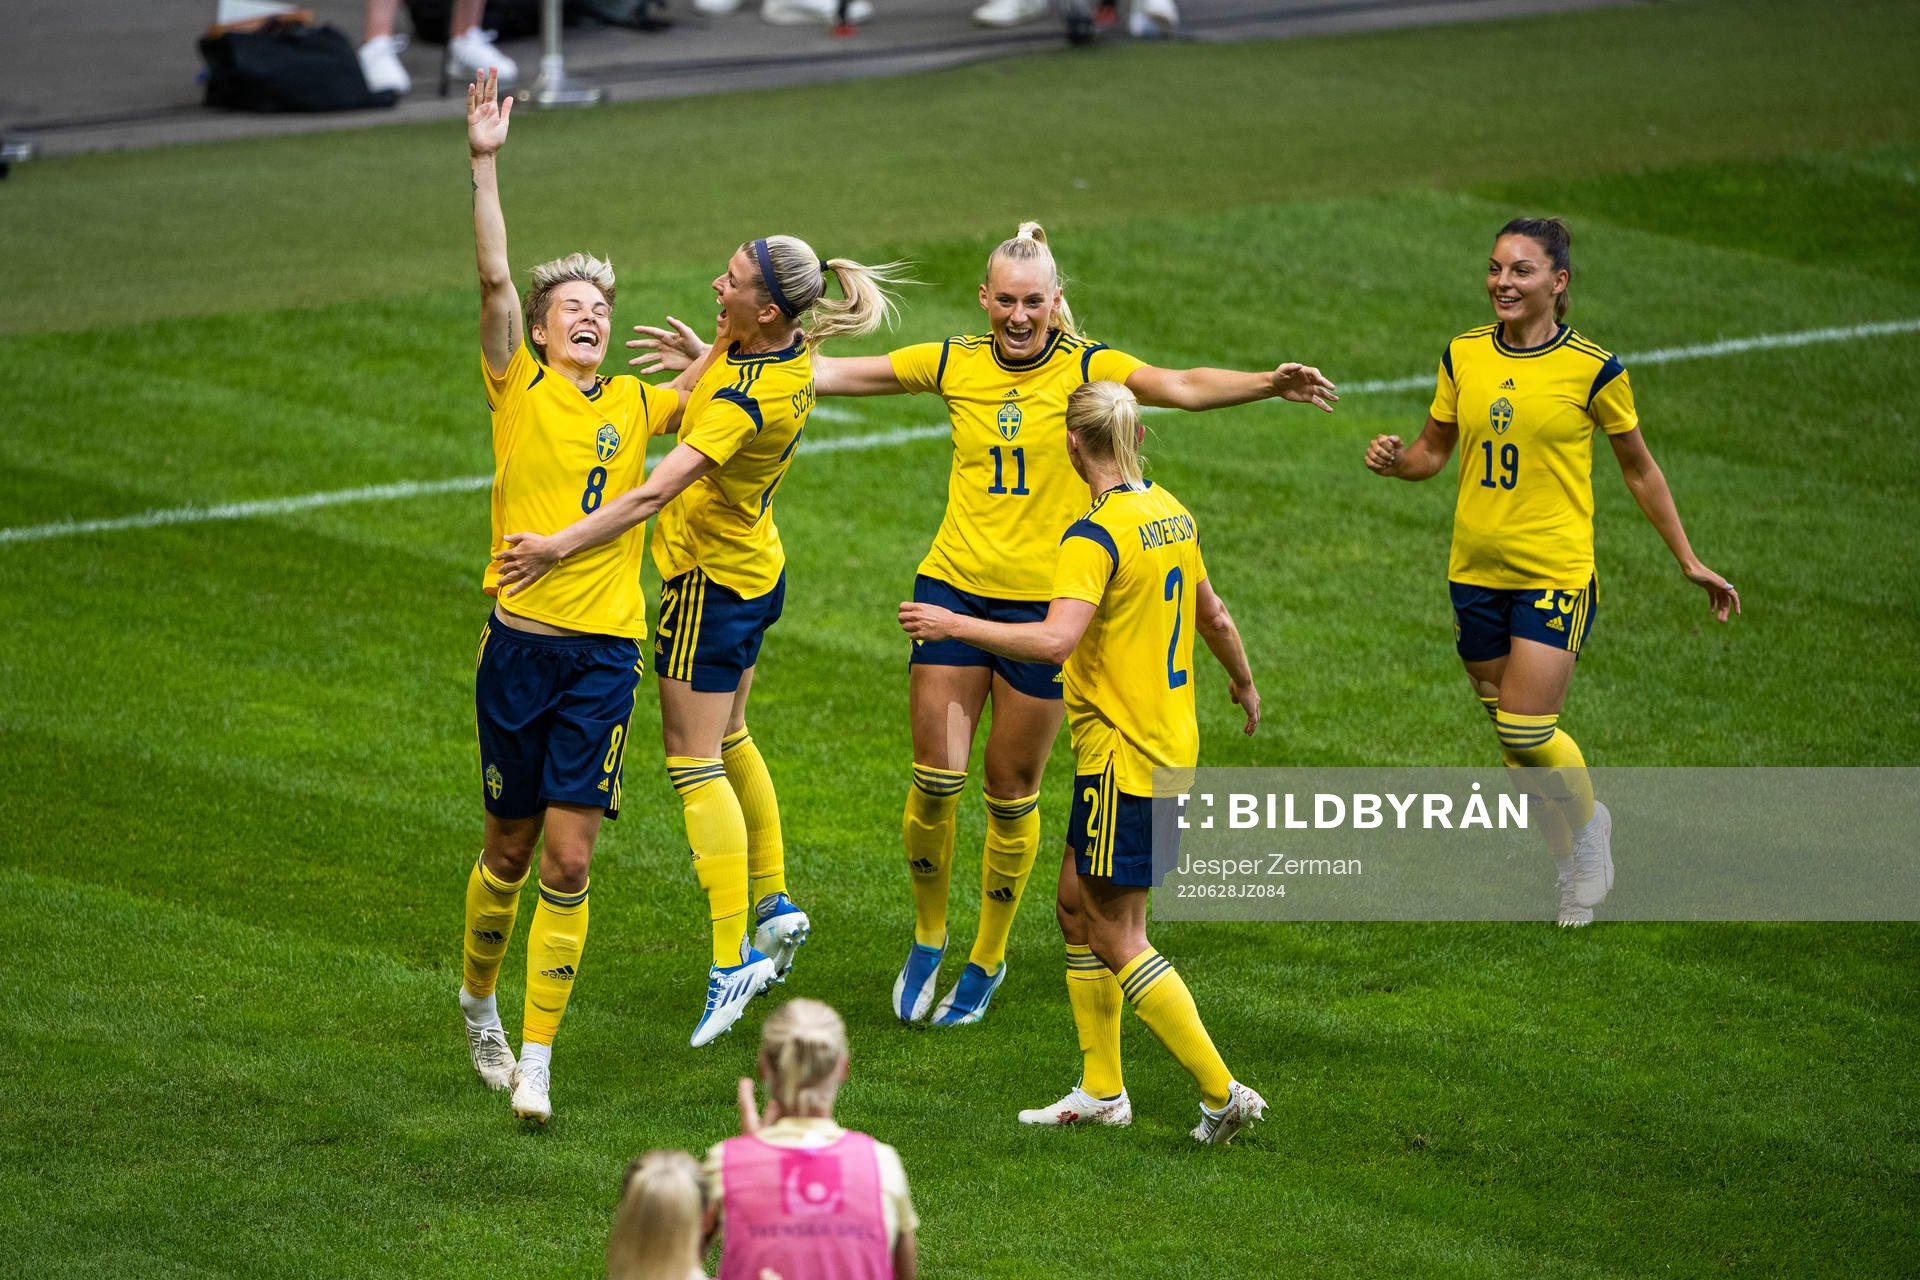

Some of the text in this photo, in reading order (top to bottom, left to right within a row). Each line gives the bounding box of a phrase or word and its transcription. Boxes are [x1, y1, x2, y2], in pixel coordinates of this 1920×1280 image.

[988, 446, 1030, 496] 11
[1481, 440, 1519, 490] 19
[581, 466, 607, 515] 8
[1164, 565, 1187, 690] 2
[603, 724, 623, 774] 8
[1083, 787, 1099, 838] 2
